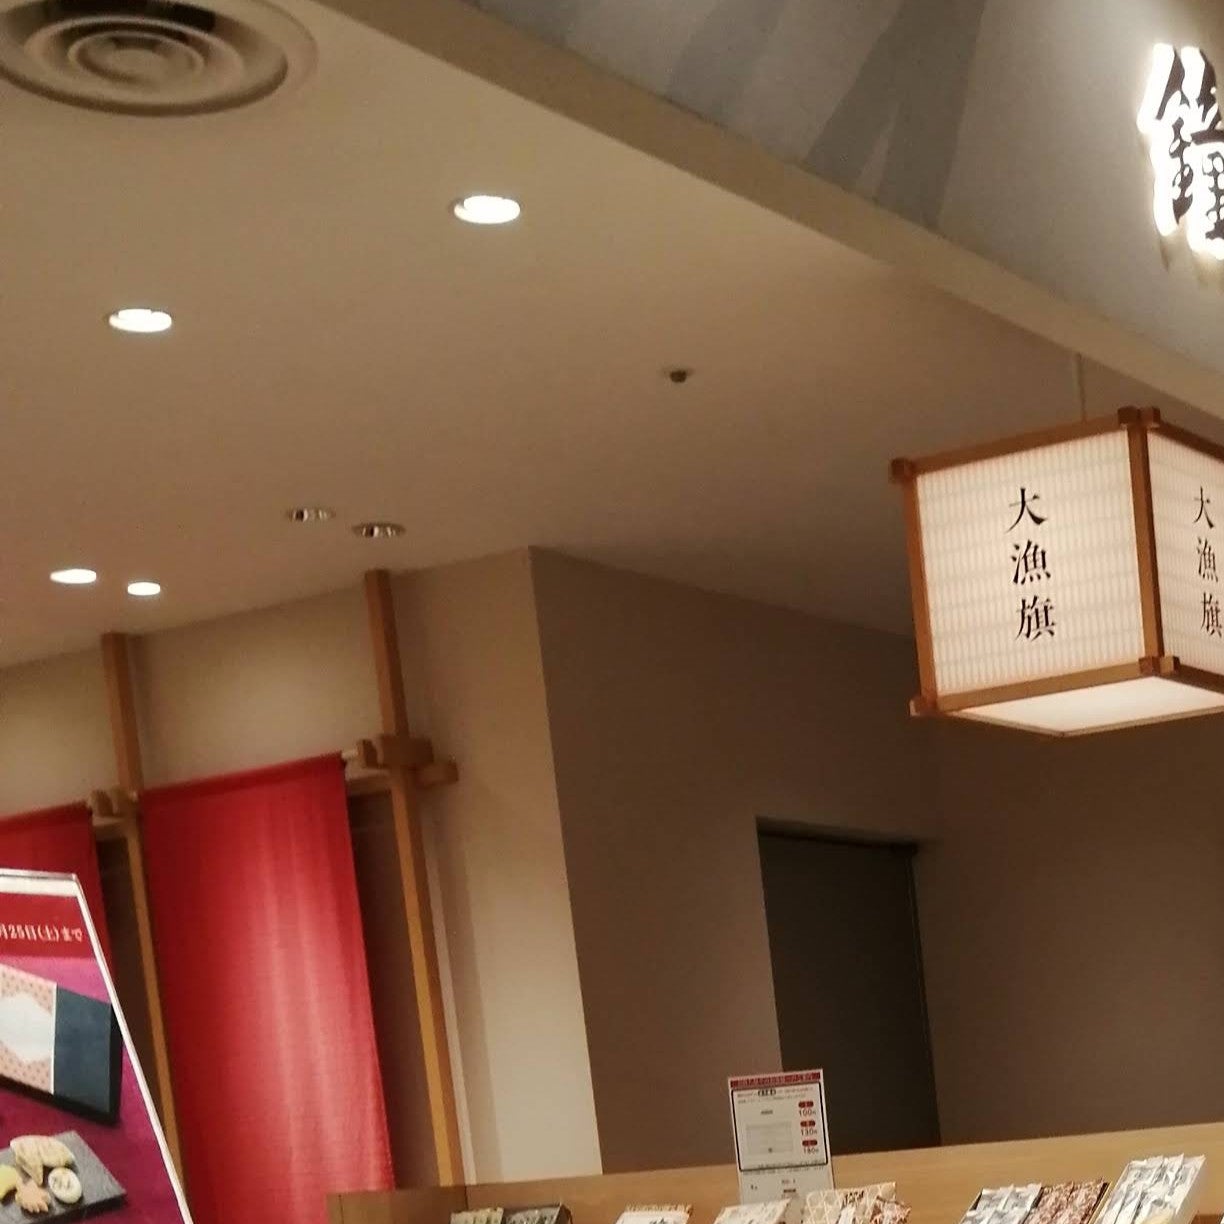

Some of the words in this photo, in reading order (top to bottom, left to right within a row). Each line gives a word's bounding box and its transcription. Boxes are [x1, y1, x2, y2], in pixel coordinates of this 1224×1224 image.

[1007, 487, 1056, 642] 大漁旗
[1193, 486, 1223, 638] 大漁旗
